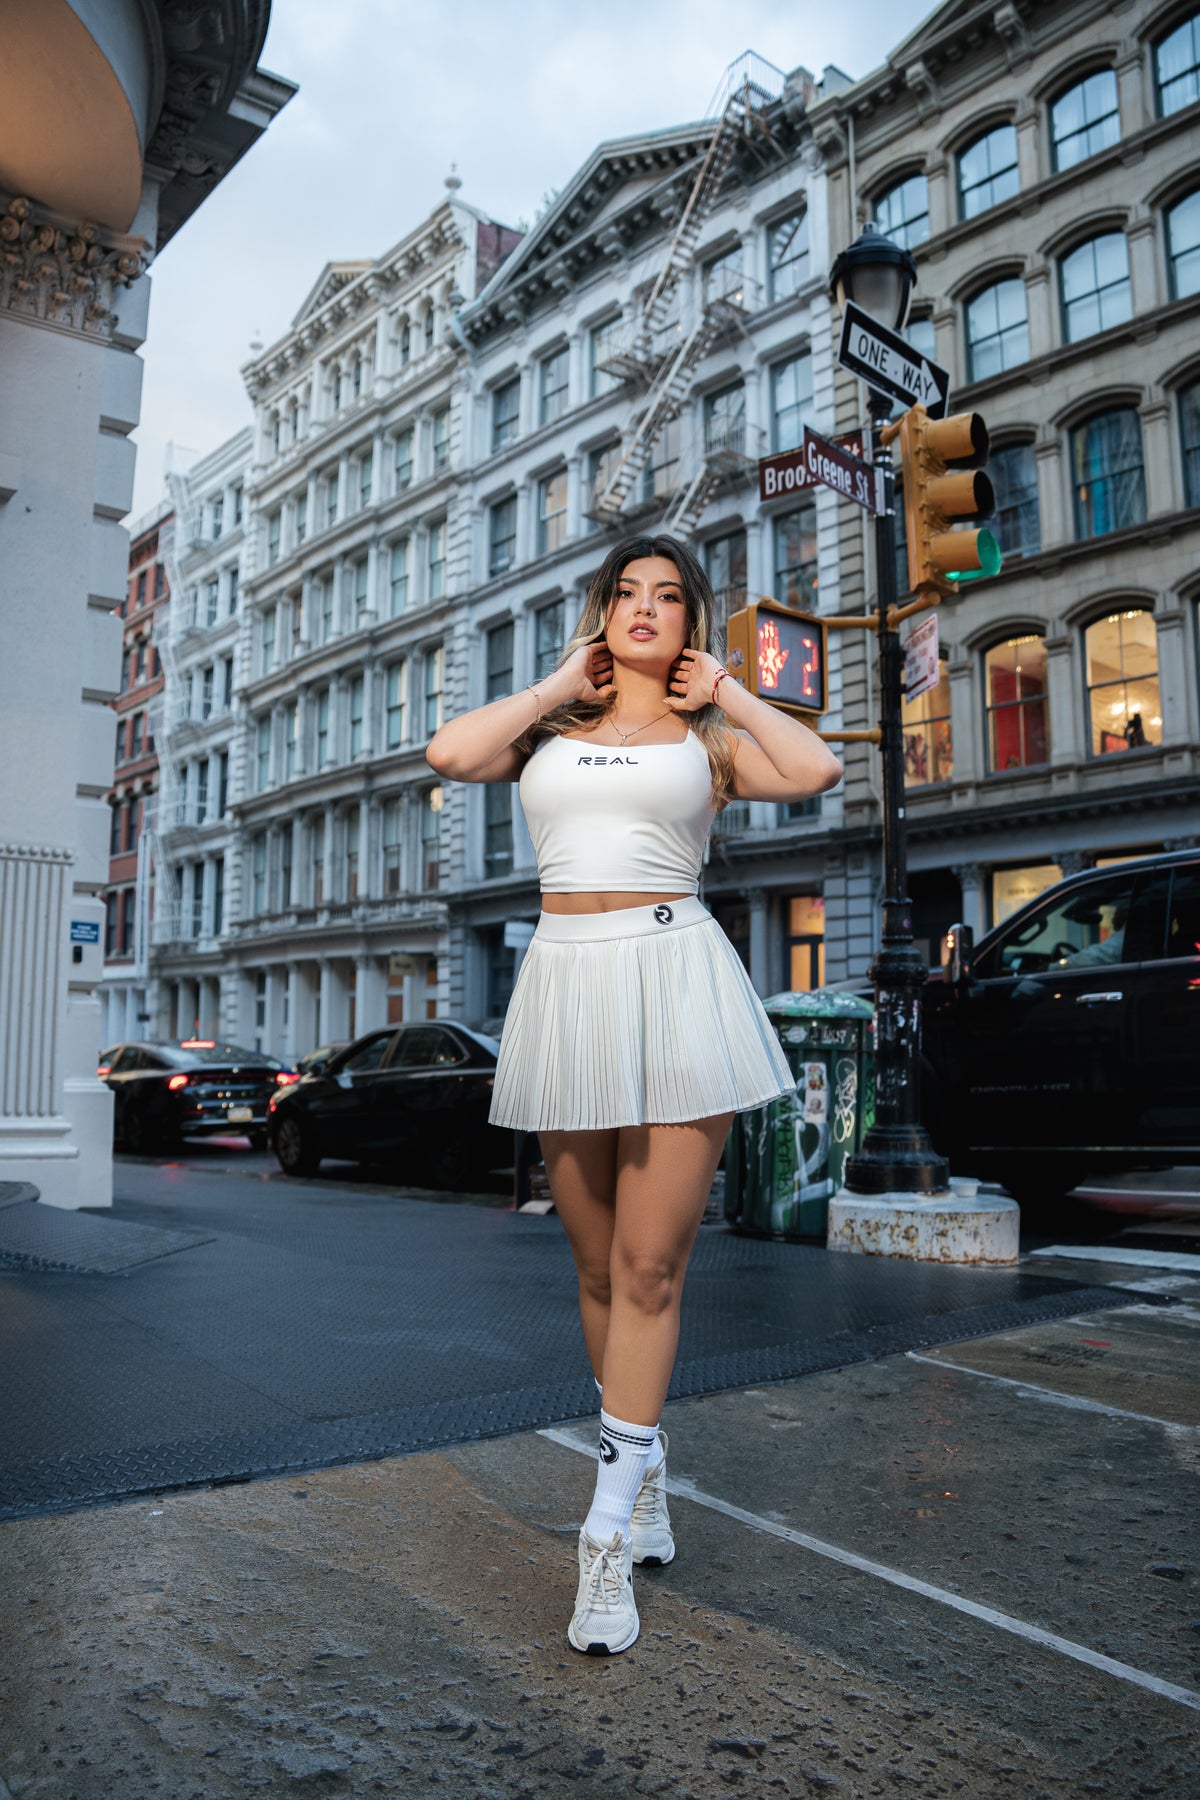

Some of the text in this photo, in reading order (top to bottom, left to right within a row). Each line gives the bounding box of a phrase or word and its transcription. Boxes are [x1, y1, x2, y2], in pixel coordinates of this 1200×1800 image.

[858, 334, 889, 373] ONE
[903, 363, 933, 400] WAY
[808, 441, 869, 504] Greene St
[578, 756, 638, 765] REAL
